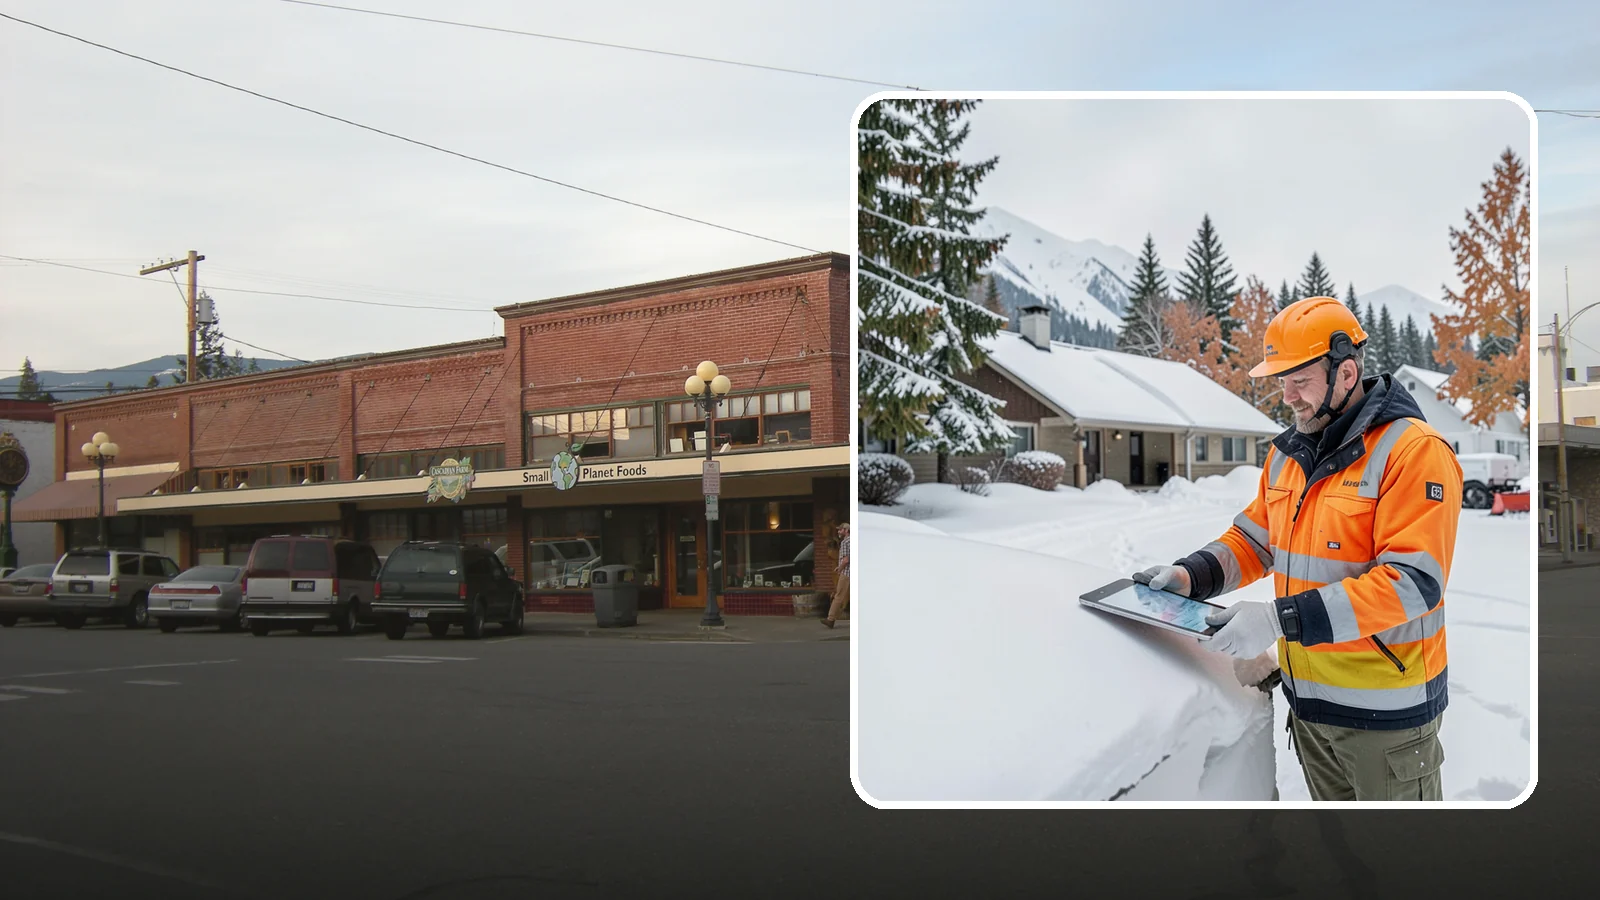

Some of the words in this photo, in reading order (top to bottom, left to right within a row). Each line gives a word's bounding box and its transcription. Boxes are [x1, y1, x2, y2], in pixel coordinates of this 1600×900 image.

[523, 471, 549, 483] Small
[582, 467, 614, 479] Planet
[617, 464, 647, 477] Foods
